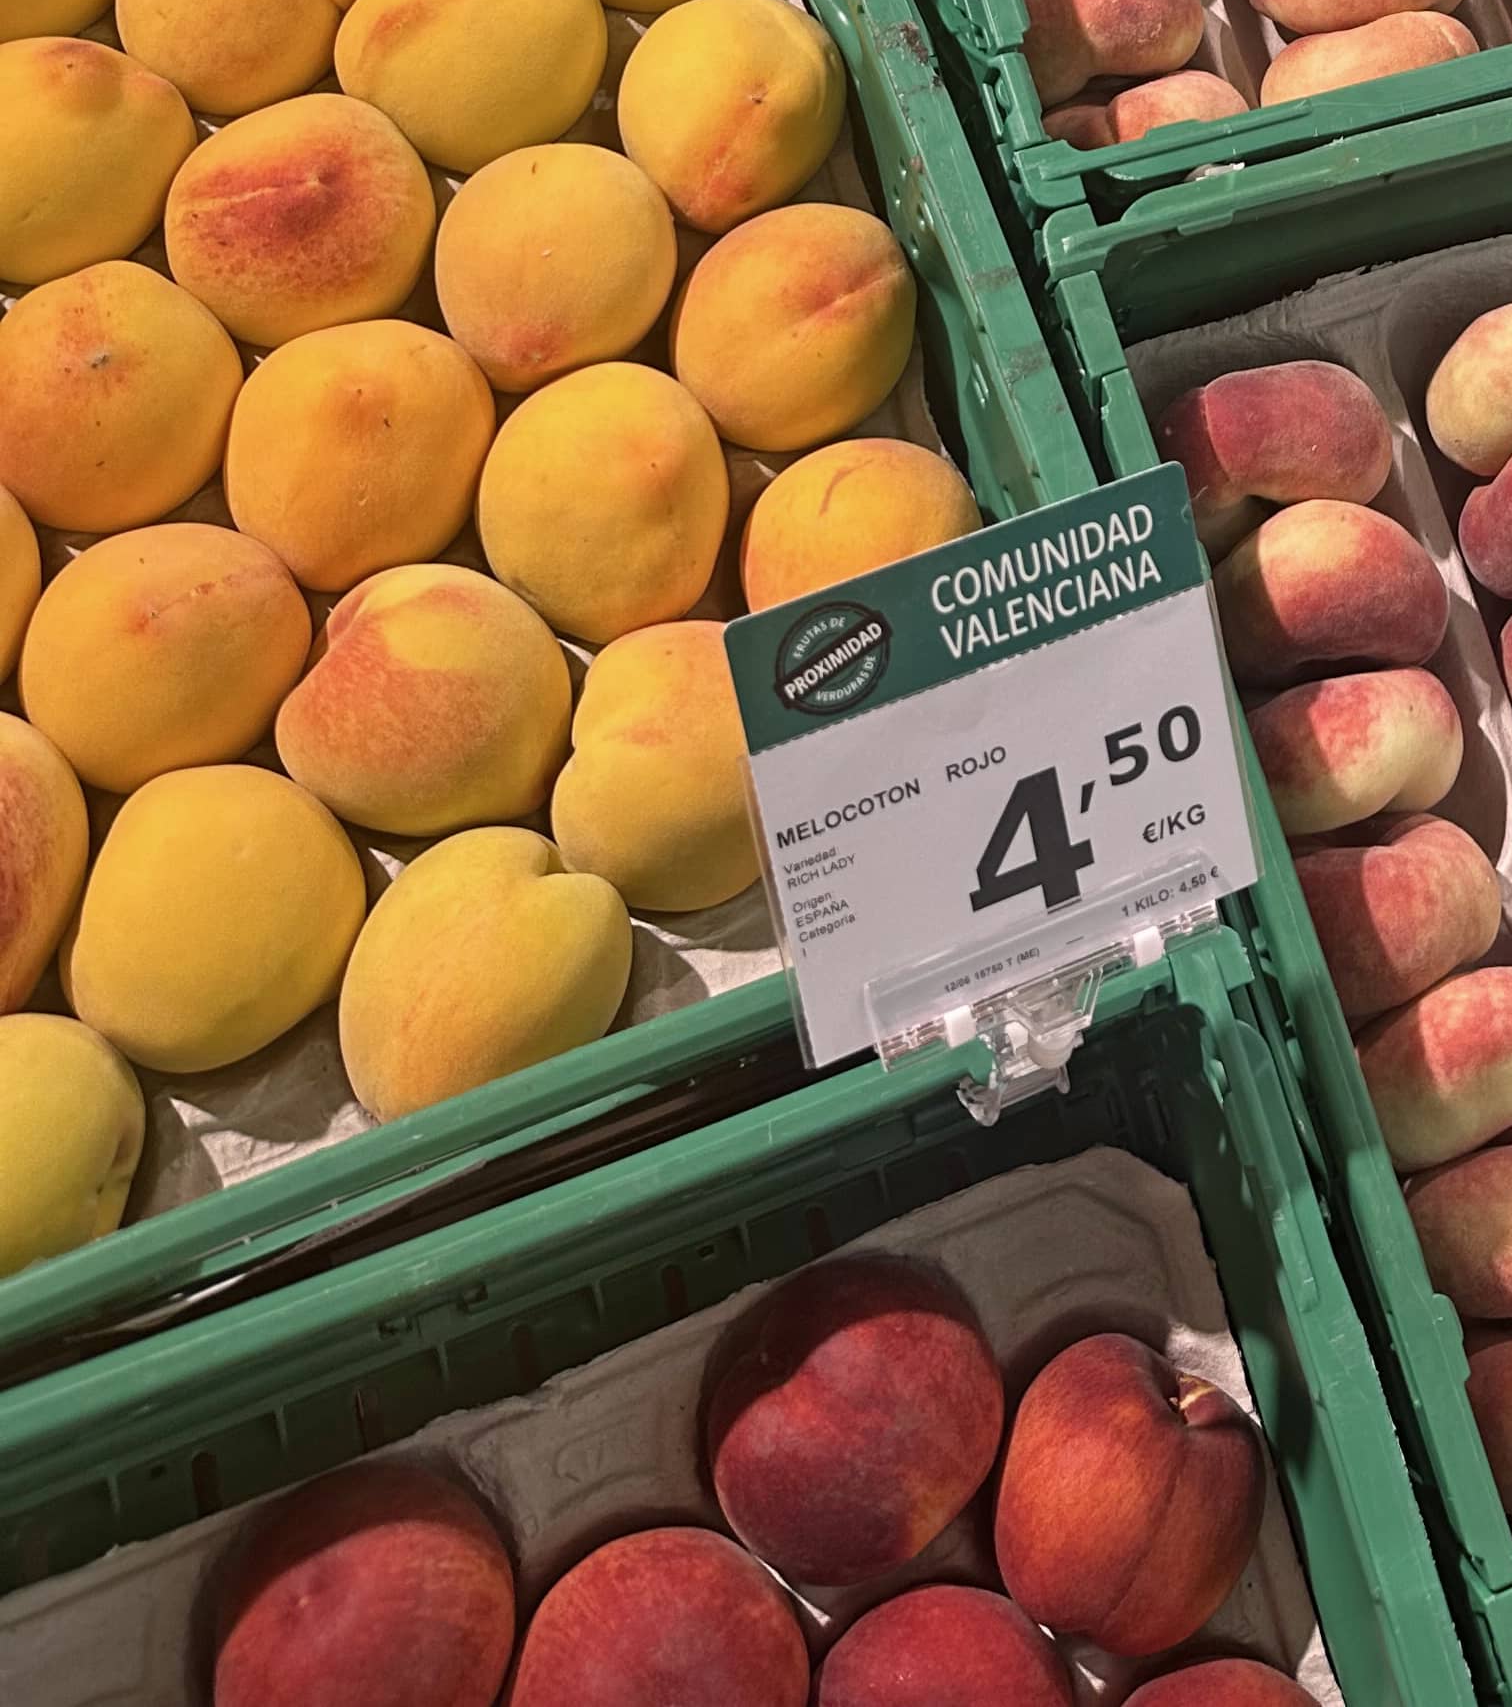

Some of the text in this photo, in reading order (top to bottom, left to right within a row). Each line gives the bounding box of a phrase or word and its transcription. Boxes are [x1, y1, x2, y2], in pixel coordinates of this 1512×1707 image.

[932, 504, 1153, 613] COMUNIDAD
[940, 550, 1161, 659] VALENCIANA
[793, 616, 846, 659] FRUTAS DE
[784, 622, 882, 700] PROXIMIDAD
[816, 655, 877, 701] VERDURAS DE
[776, 746, 1006, 848] MELOCOTON ROJO
[1142, 802, 1207, 844] €/KG
[787, 853, 856, 890] RICH LADY
[1134, 888, 1176, 914] KILO:
[1179, 870, 1207, 895] 4,50
[796, 899, 849, 928] ESPAÑA
